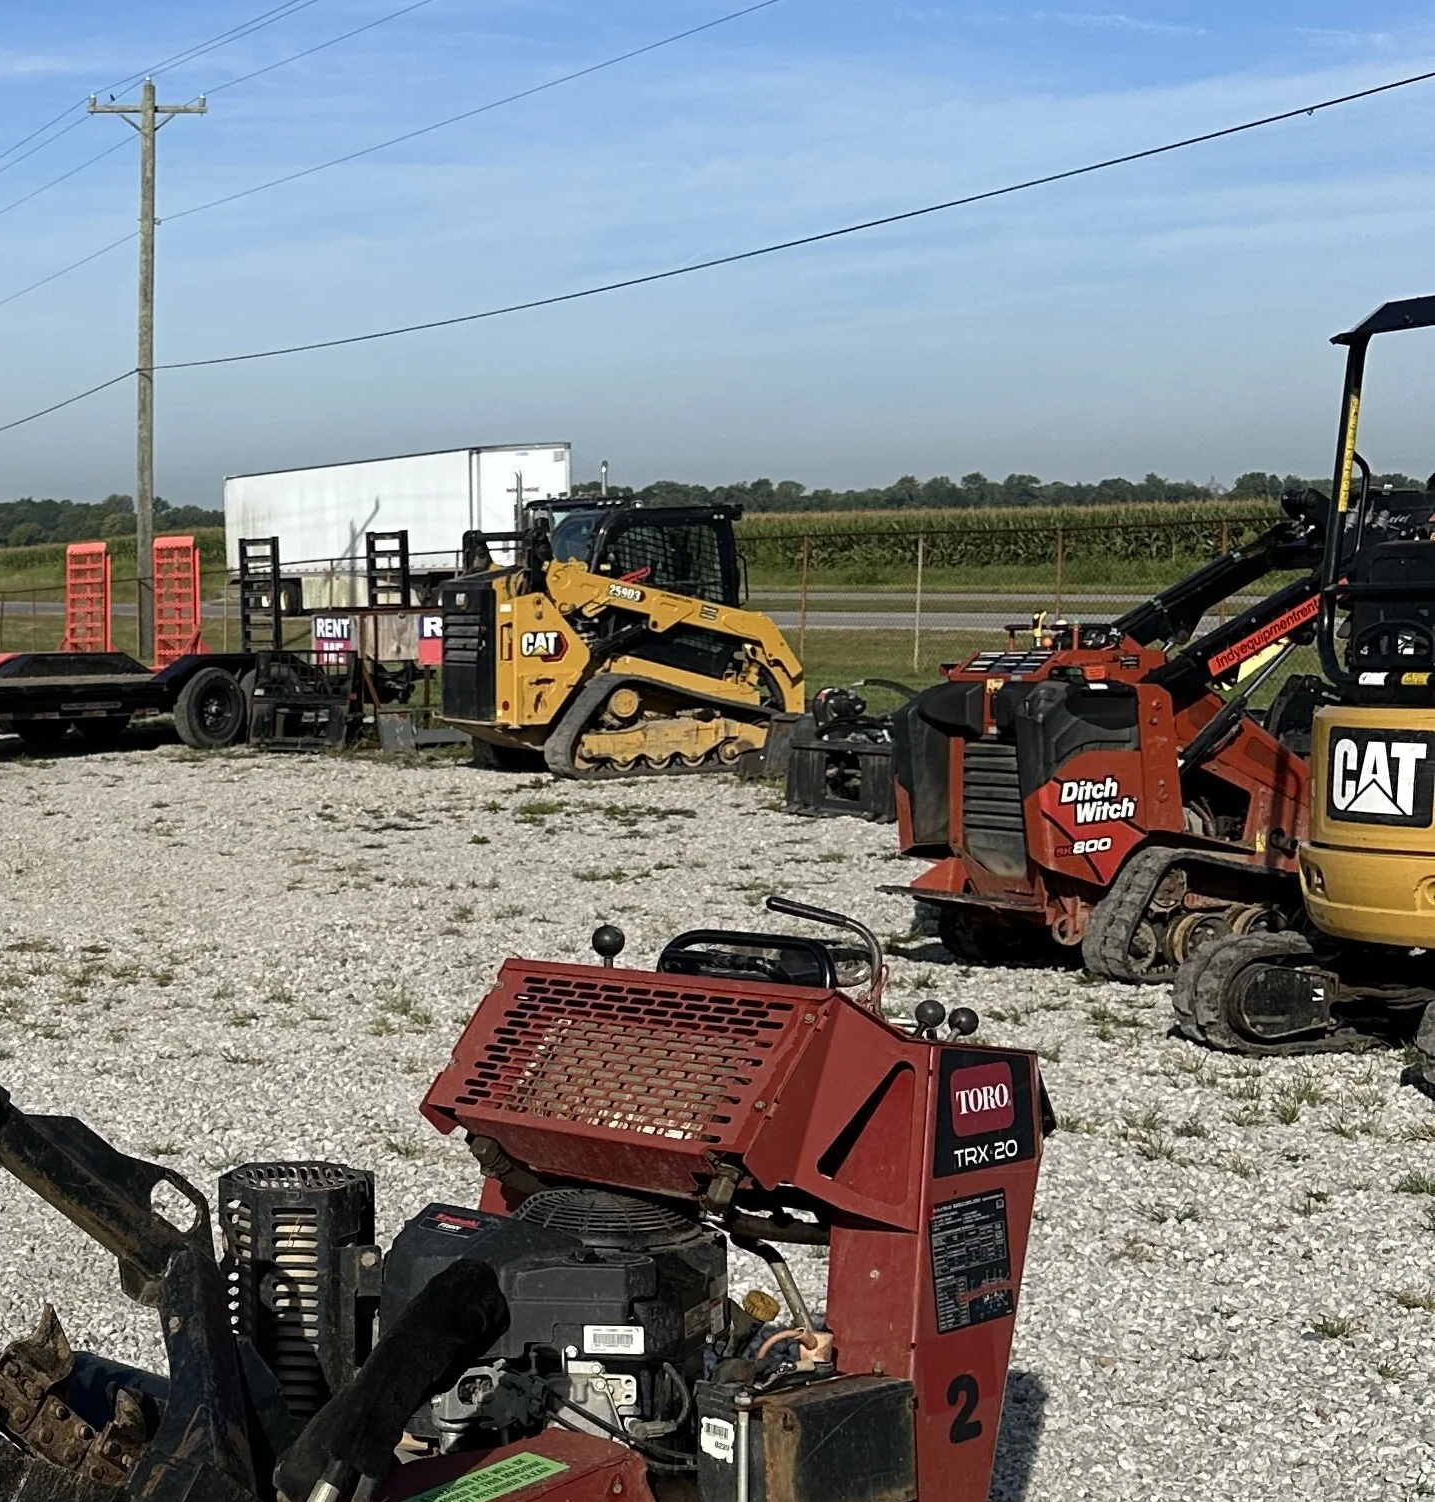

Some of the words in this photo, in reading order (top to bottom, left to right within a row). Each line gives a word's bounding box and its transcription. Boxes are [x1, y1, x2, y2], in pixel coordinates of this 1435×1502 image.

[316, 618, 350, 638] RENT
[1216, 598, 1319, 668] Indyequipmentrent
[521, 632, 558, 656] CAT
[1060, 777, 1118, 803] Ditch
[1333, 738, 1428, 816] CAT
[1076, 797, 1135, 824] Witch
[956, 1083, 1009, 1115] TORO
[947, 1373, 983, 1444] 2
